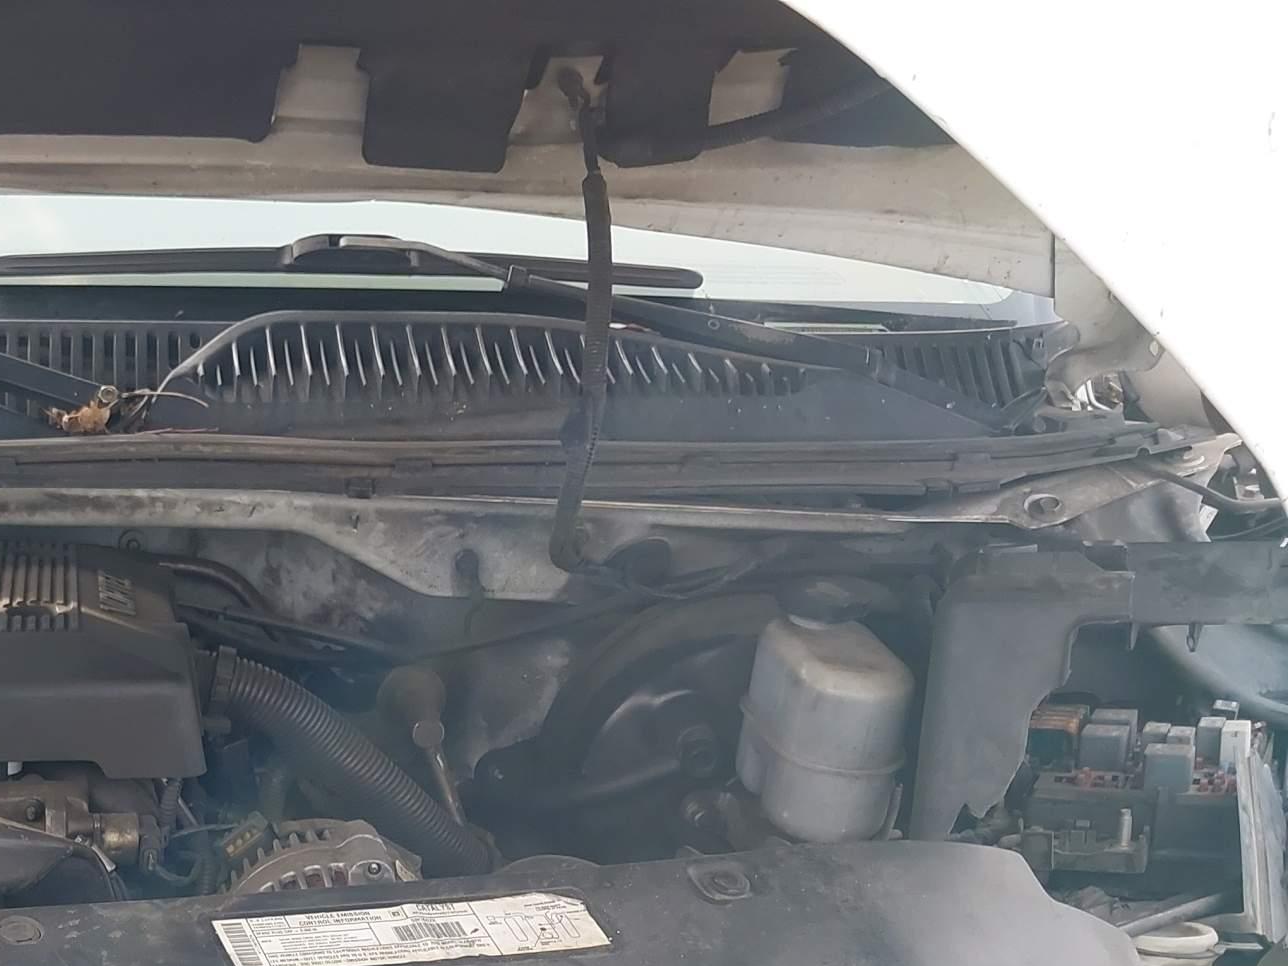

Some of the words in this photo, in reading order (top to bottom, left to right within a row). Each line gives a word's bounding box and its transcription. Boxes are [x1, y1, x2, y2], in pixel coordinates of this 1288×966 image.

[415, 903, 457, 912] CATALYST
[298, 918, 332, 927] CONTROL
[333, 915, 383, 925] INFORMATION
[305, 913, 336, 921] VEHICLE
